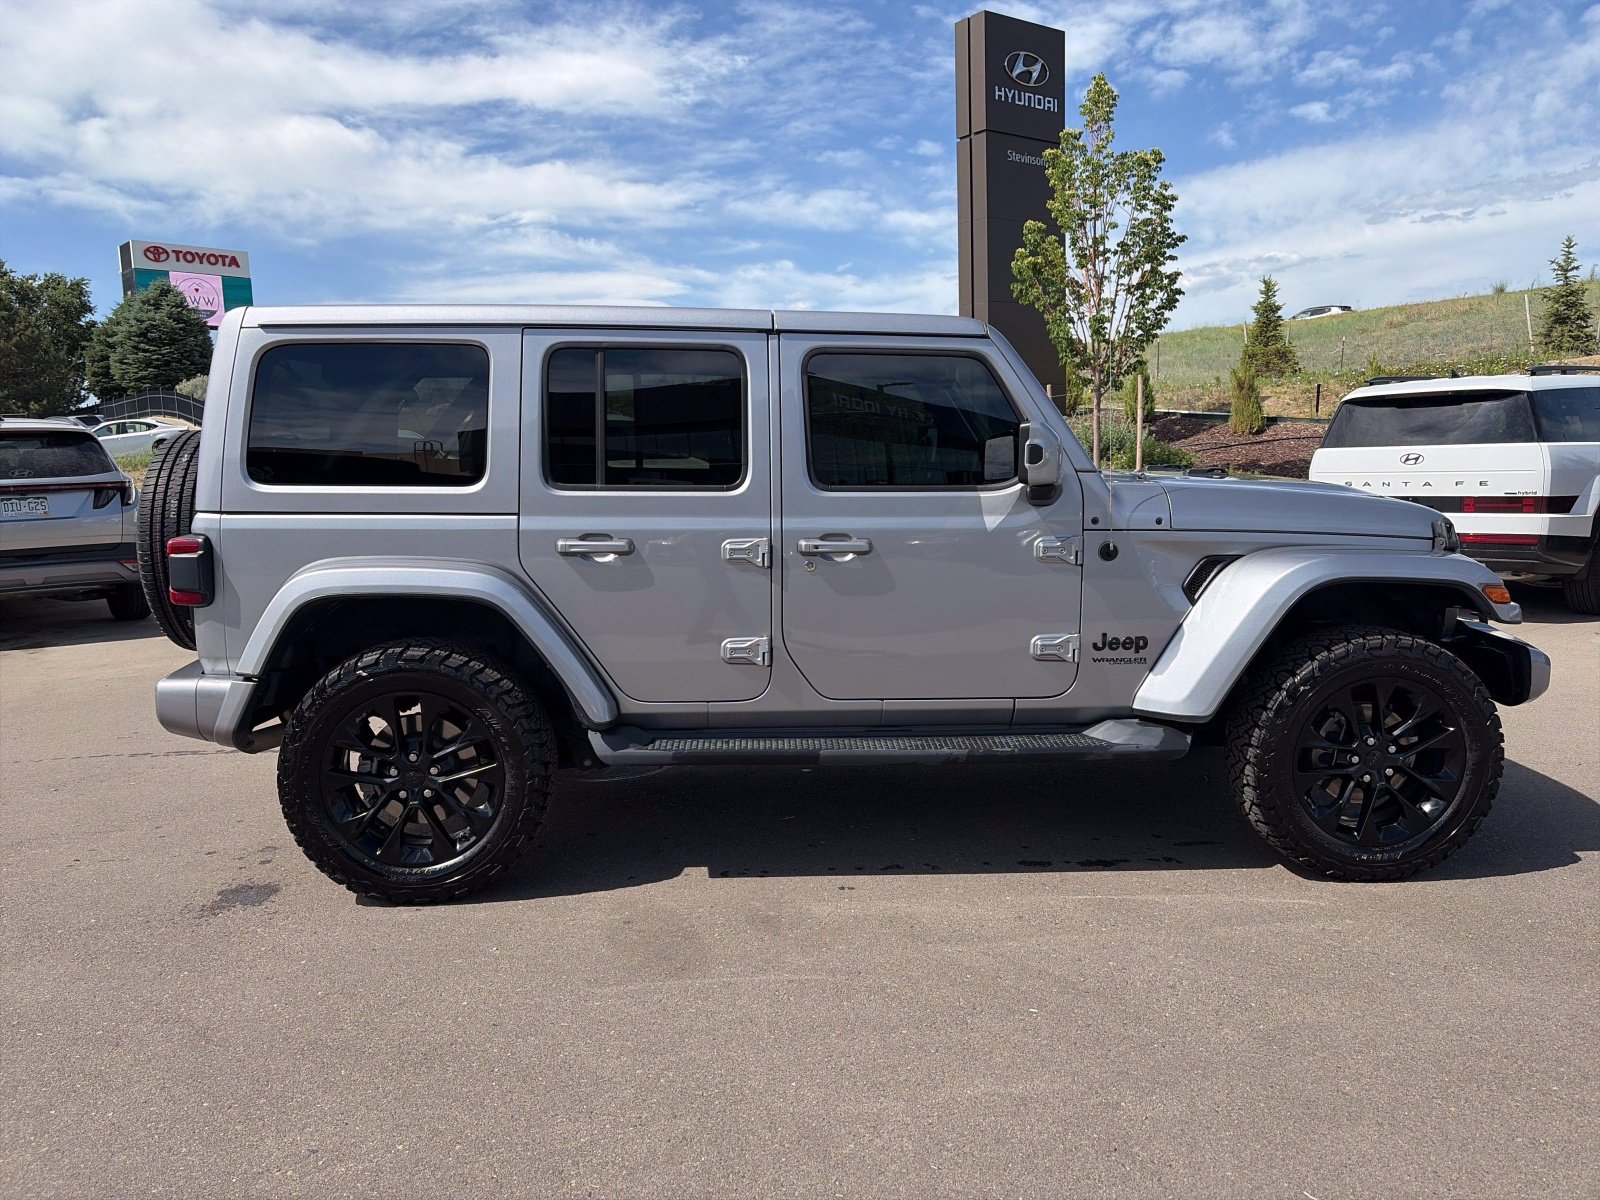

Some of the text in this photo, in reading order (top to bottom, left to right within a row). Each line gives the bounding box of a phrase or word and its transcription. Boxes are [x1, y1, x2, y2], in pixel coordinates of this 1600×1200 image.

[994, 86, 1058, 112] HYUNDAI
[1007, 150, 1046, 166] Stevinson
[172, 250, 241, 268] TOYOTA
[1092, 632, 1149, 654] Jeep
